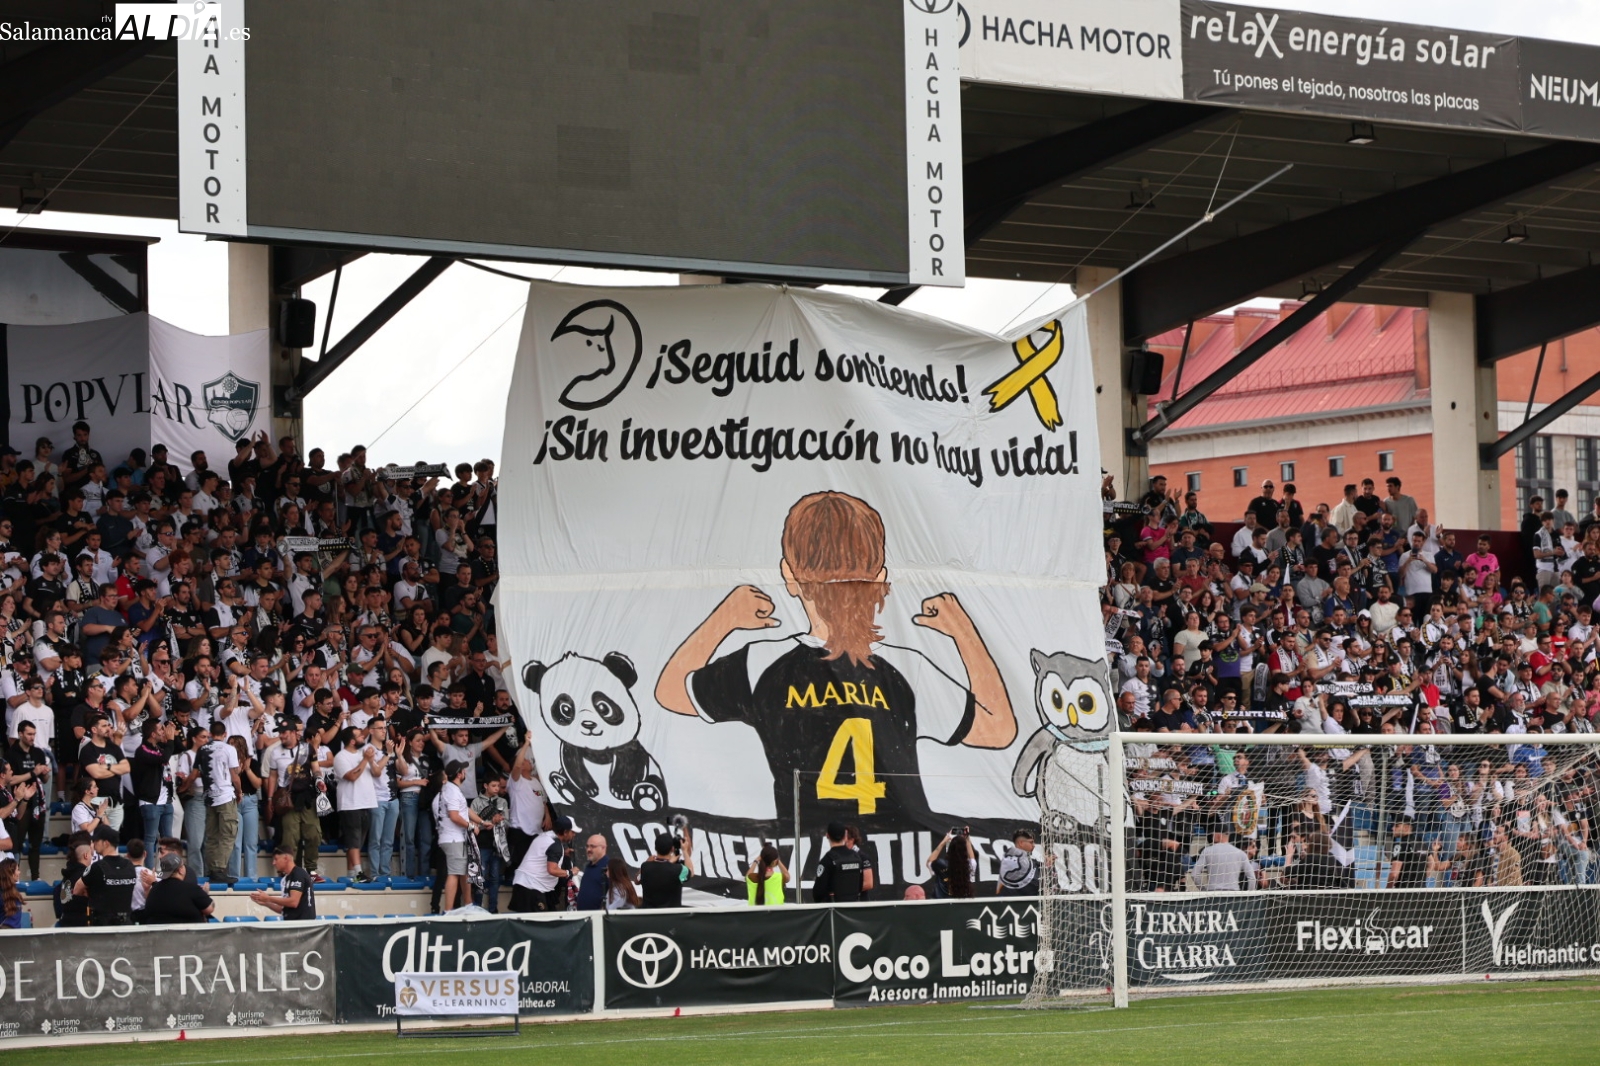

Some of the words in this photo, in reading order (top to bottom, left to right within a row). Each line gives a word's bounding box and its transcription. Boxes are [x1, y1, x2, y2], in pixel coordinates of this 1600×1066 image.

[982, 15, 1073, 50] HACHA
[1081, 26, 1171, 60] MOTOR
[1190, 11, 1284, 59] relaX
[1289, 25, 1405, 65] energía
[1416, 35, 1495, 69] solar
[925, 28, 941, 142] HACHA
[1213, 69, 1230, 86] Tú
[1234, 74, 1279, 91] pones
[1282, 76, 1294, 92] el
[1298, 78, 1346, 100] tejado,
[1349, 86, 1408, 104] nosotros
[1411, 89, 1431, 106] las
[1434, 92, 1479, 111] placas
[1530, 73, 1600, 108] NEUM
[202, 96, 221, 224] MOTOR
[926, 161, 944, 276] MOTOR
[645, 338, 804, 397] ¡Seguid
[814, 348, 970, 404] sonriendo!
[532, 415, 609, 464] ¡Sin
[620, 416, 882, 473] investigación
[890, 431, 929, 466] no
[931, 431, 984, 488] hay
[990, 430, 1080, 478] vida!
[785, 679, 891, 711] MARÍA
[816, 717, 886, 815] 4
[867, 831, 933, 884] TU
[1131, 904, 1239, 935] TERNERA
[1297, 919, 1361, 951] Flexi
[1391, 924, 1434, 949] car
[690, 948, 759, 969] HACHA
[763, 944, 831, 966] MOTOR
[838, 932, 930, 983] Coco
[1138, 938, 1237, 970] CHARRA
[1504, 942, 1587, 966] Helmantic
[0, 961, 36, 1002] E
[55, 957, 134, 999] LOS
[154, 950, 325, 996] FRAILES
[420, 979, 515, 997] VERSUS
[522, 980, 571, 994] LABORAL
[868, 985, 927, 1003] Asesora
[933, 980, 1028, 999] Inmobiliaria
[432, 998, 507, 1007] E-LEARNING
